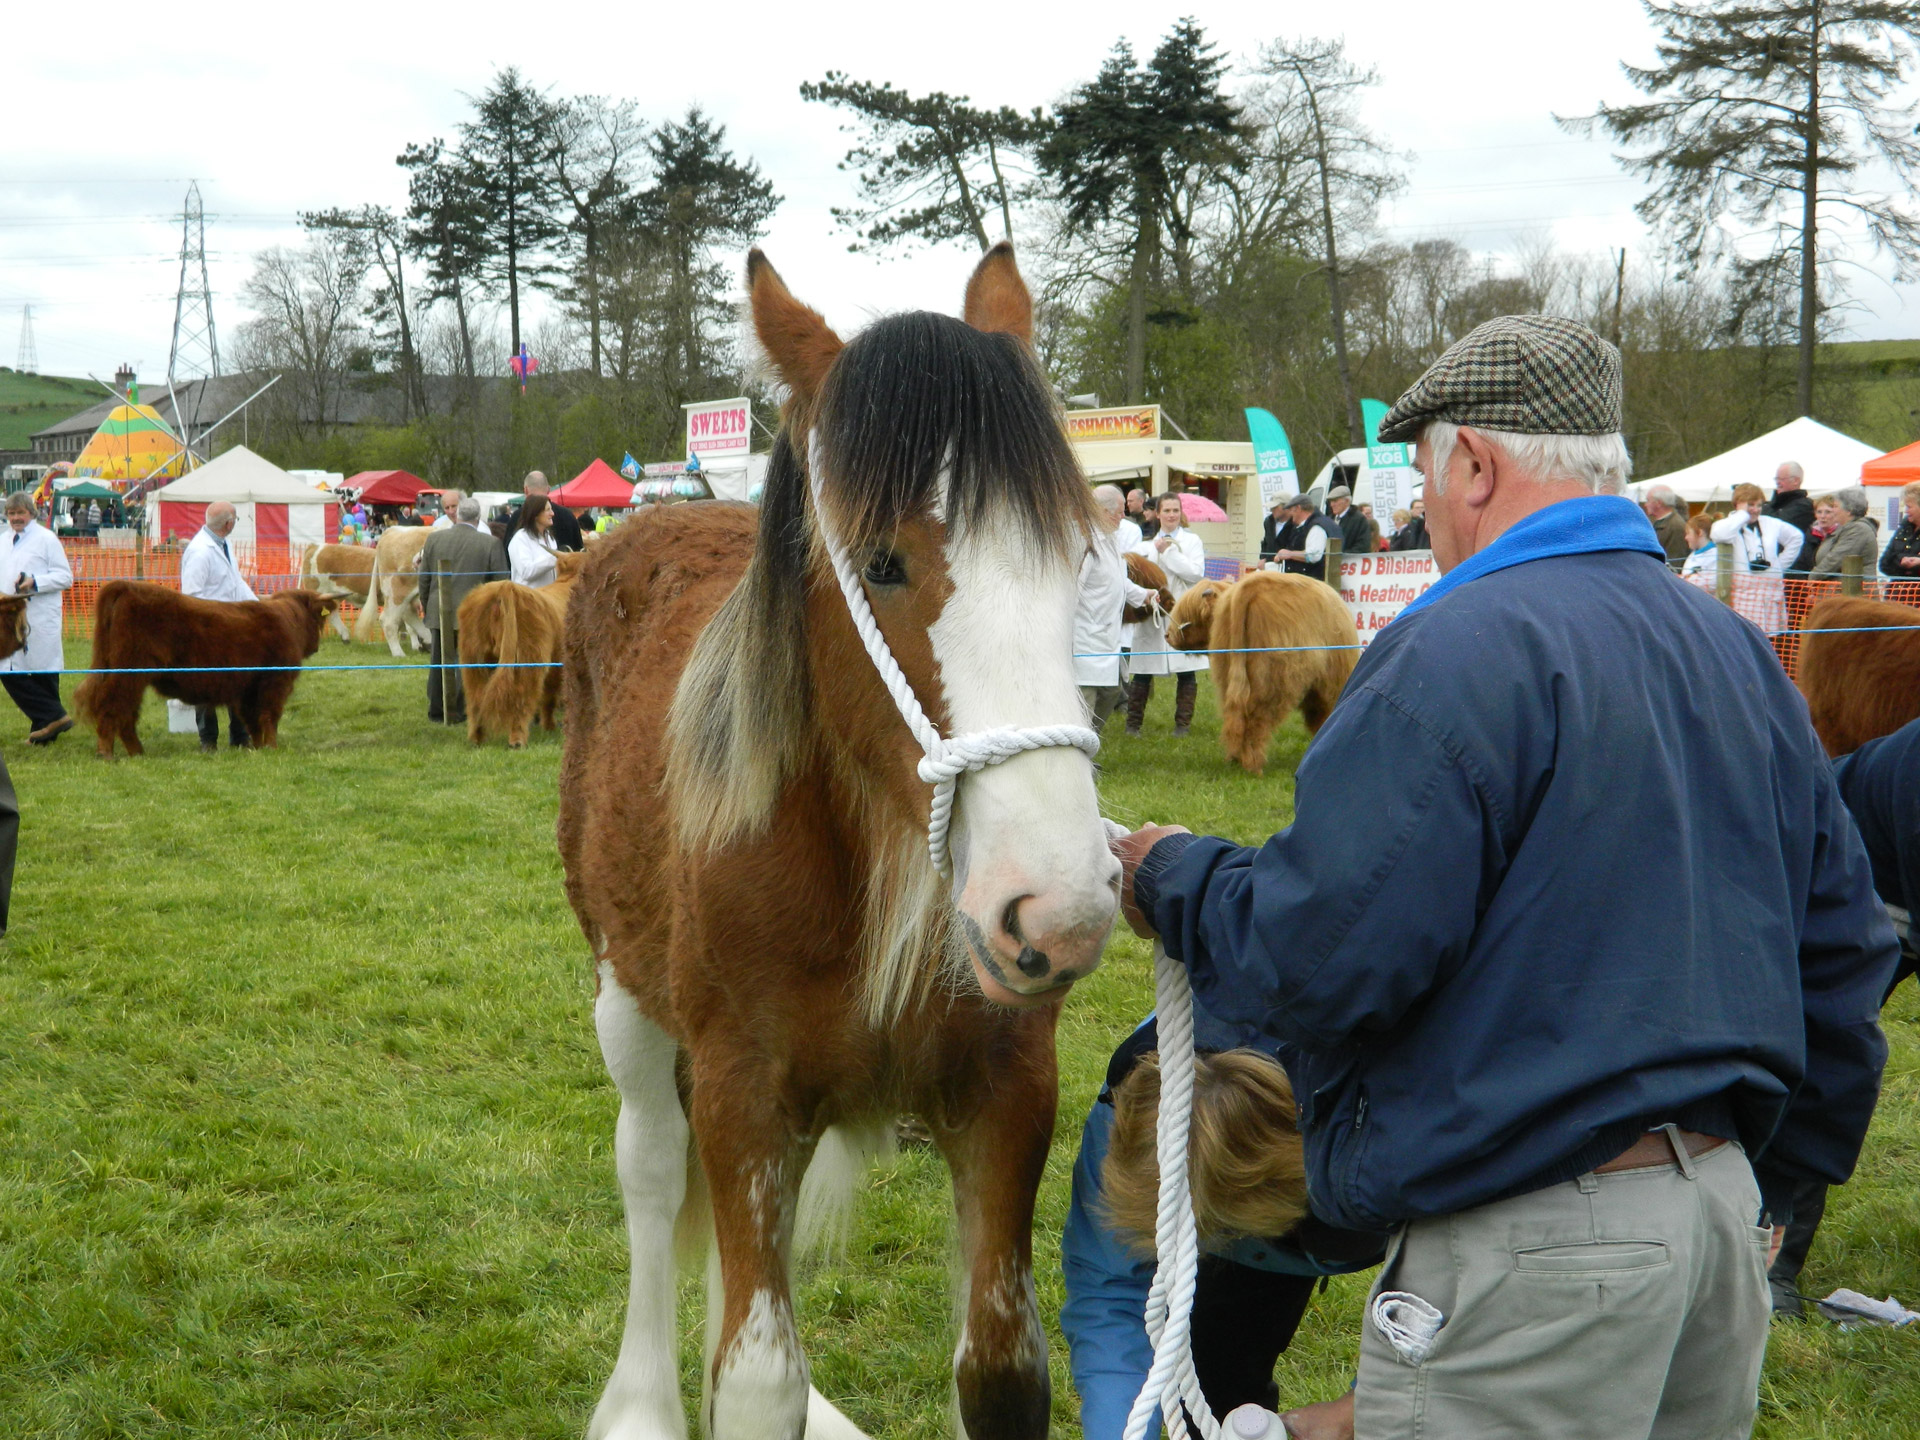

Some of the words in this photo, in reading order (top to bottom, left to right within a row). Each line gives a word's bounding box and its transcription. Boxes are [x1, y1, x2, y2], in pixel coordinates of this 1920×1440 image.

[691, 408, 746, 437] SWEETS
[1212, 463, 1240, 471] CHIPS
[1360, 557, 1372, 575] D
[1376, 556, 1433, 575] Bilsland
[1360, 584, 1415, 605] Heating
[1356, 611, 1365, 630] &
